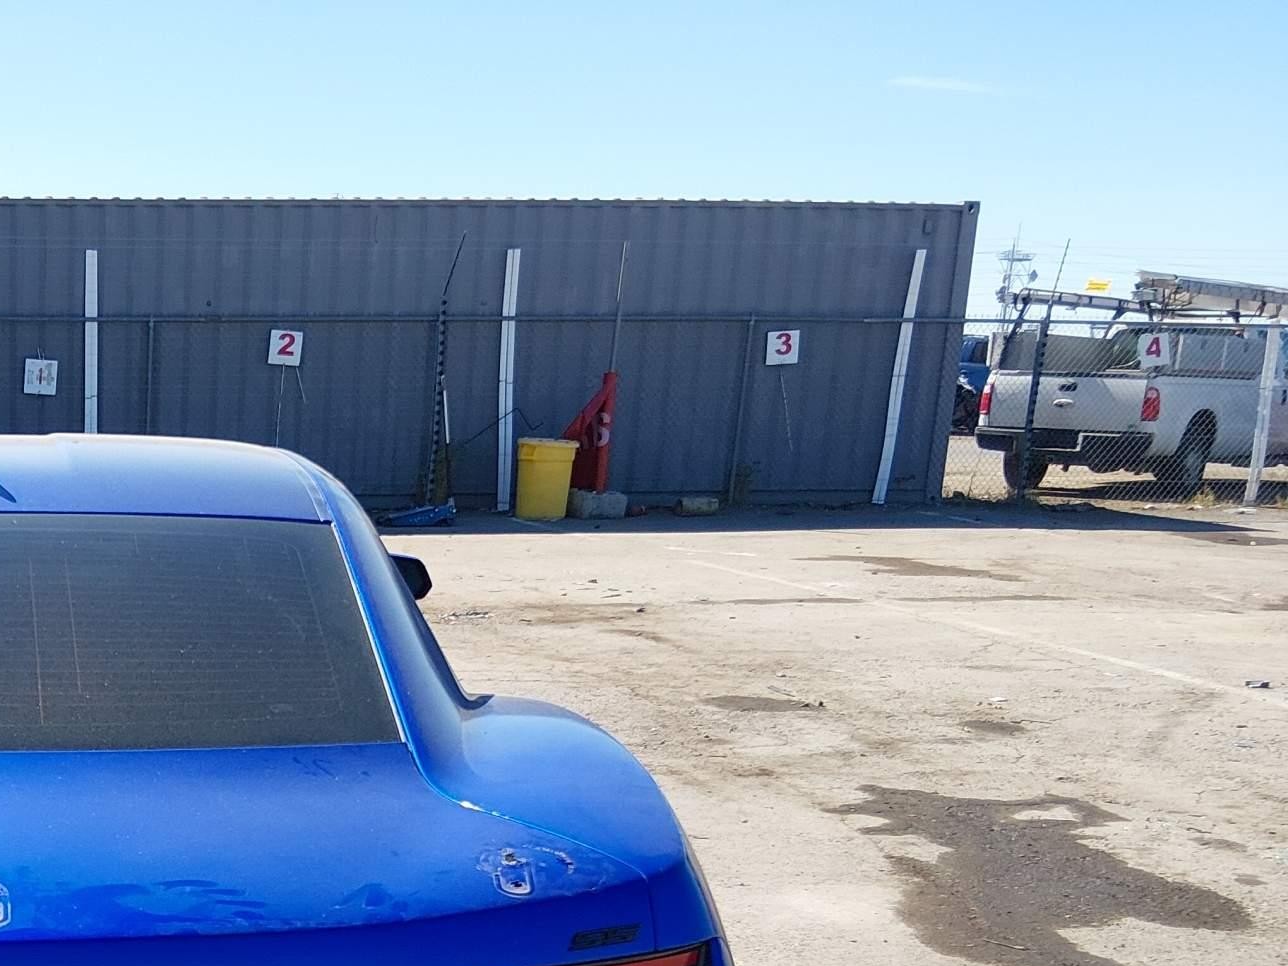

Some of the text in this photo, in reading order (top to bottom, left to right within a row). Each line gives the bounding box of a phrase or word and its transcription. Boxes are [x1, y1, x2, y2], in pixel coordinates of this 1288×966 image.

[277, 333, 295, 356] 2
[775, 333, 792, 355] 3
[1145, 336, 1161, 357] 4
[569, 922, 642, 951] SS
